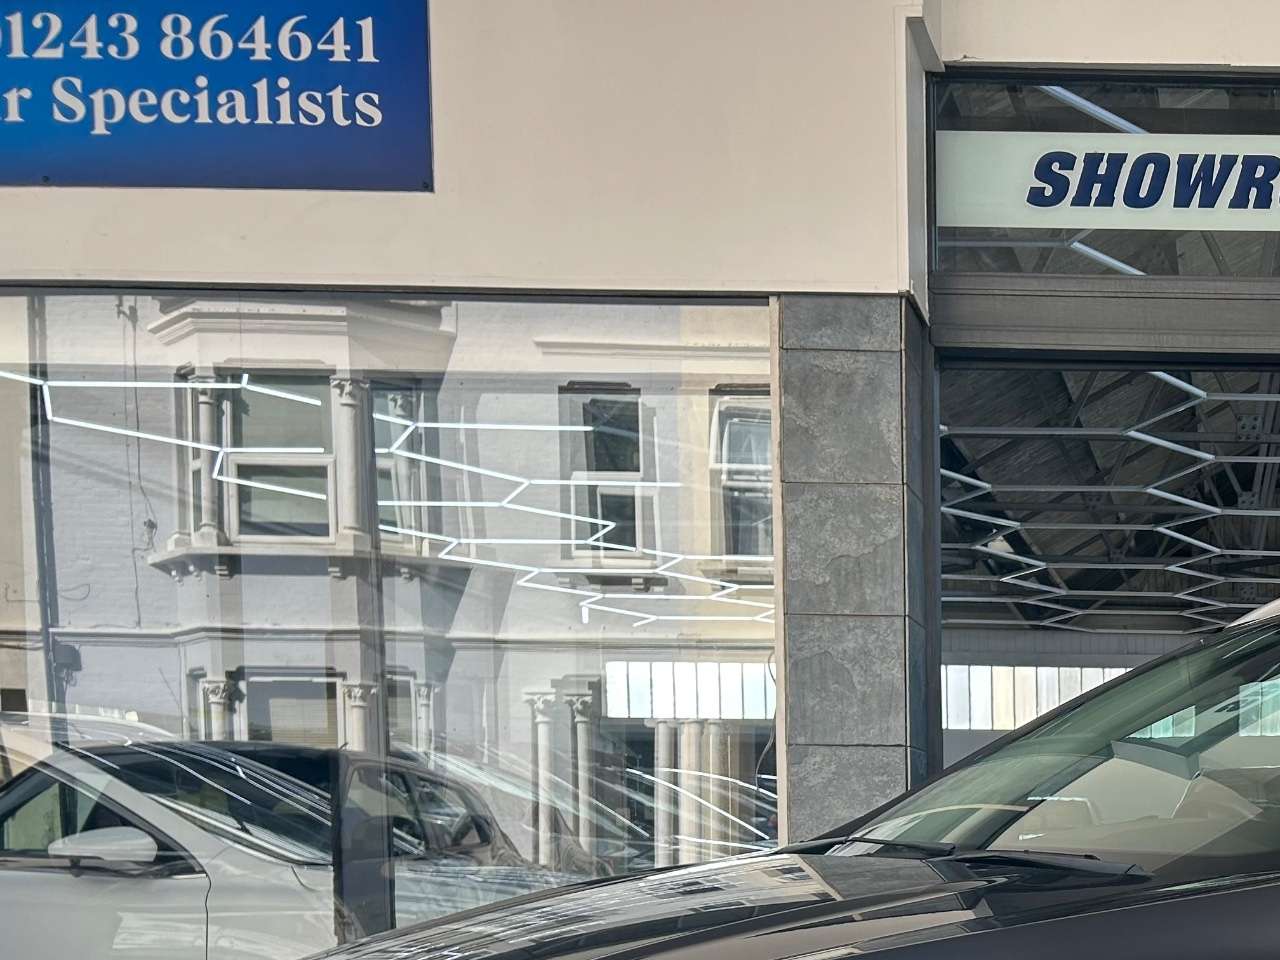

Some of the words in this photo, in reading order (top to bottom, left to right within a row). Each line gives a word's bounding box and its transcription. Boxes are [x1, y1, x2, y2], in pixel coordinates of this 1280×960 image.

[0, 12, 140, 59] 1243
[160, 14, 380, 63] 864641
[0, 87, 32, 122] r
[52, 76, 383, 135] Specialists
